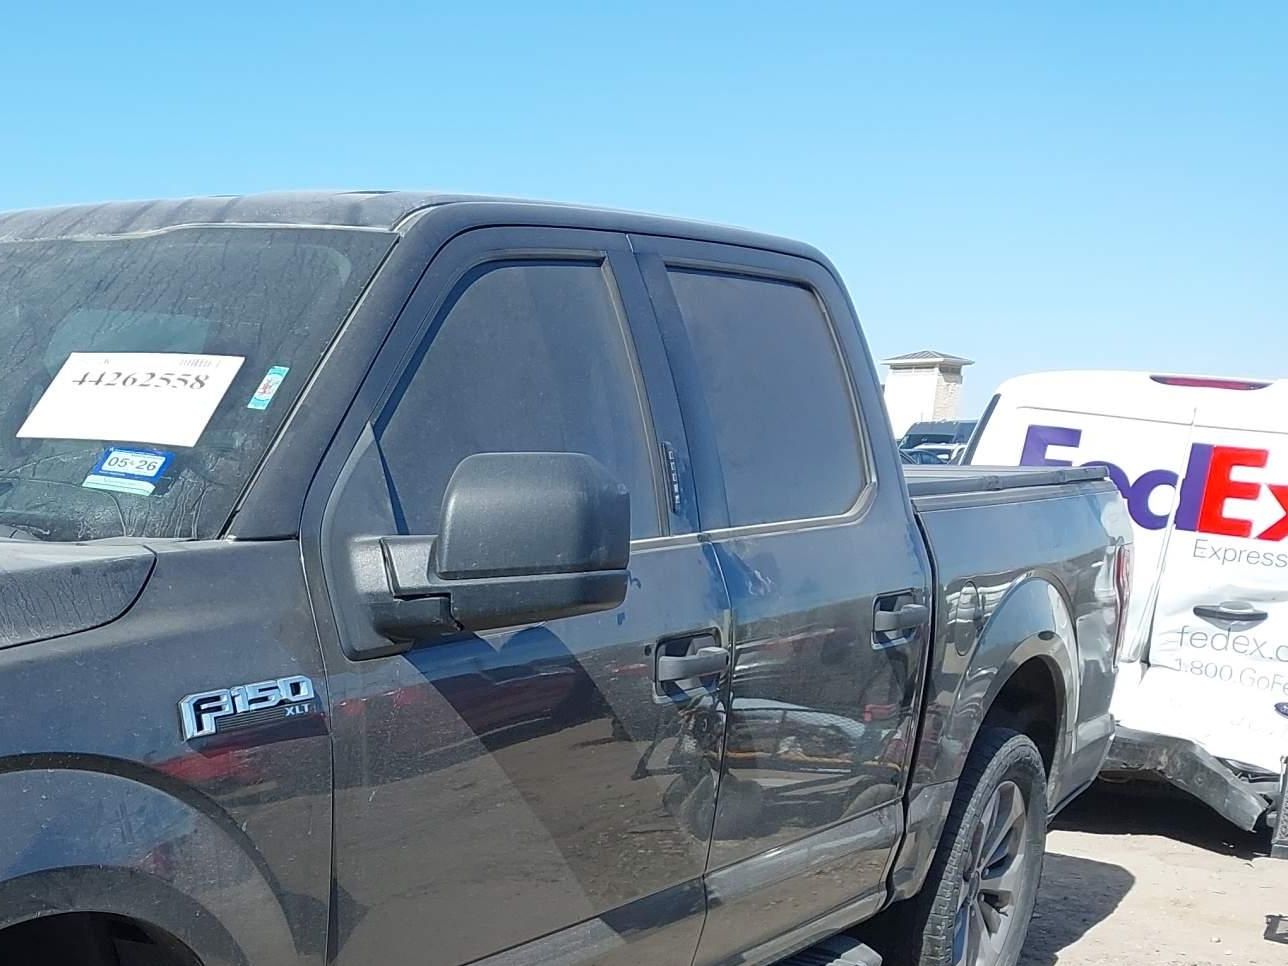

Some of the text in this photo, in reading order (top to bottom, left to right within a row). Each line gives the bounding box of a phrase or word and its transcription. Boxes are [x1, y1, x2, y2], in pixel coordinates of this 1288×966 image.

[72, 372, 210, 389] 44262558
[108, 456, 158, 471] 05 26
[1193, 539, 1288, 568] Express
[284, 703, 311, 717] XLT
